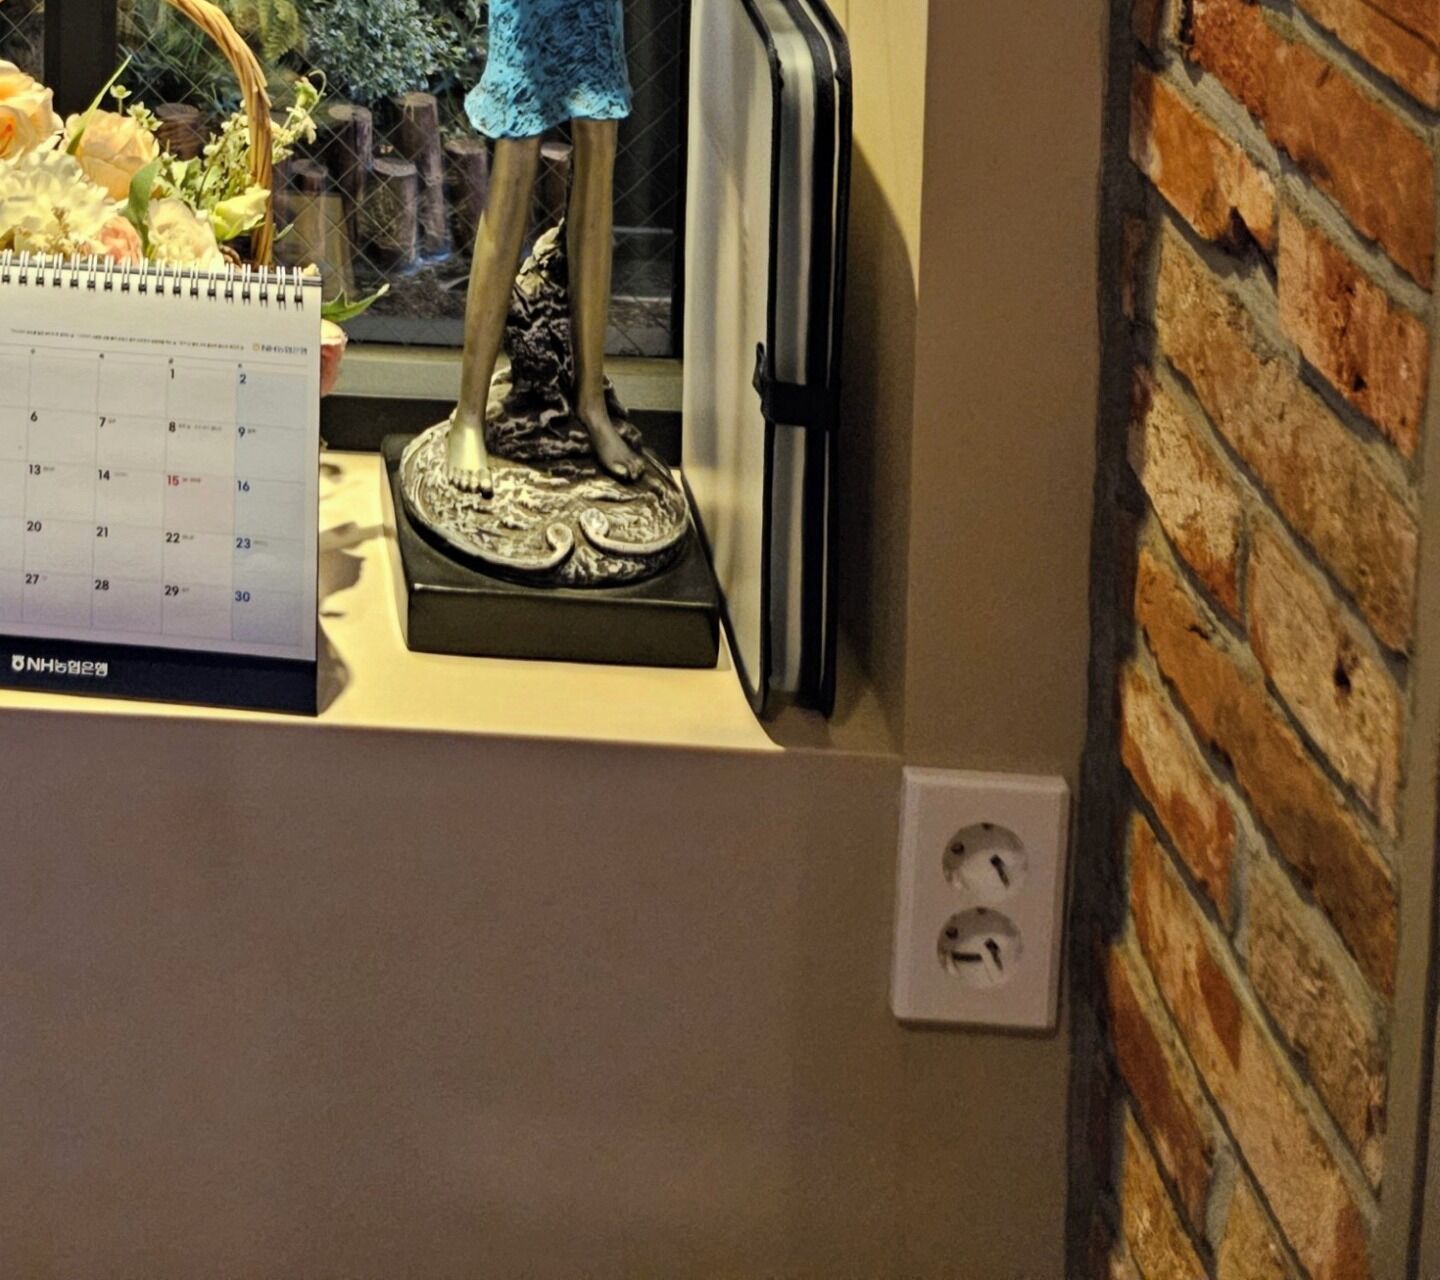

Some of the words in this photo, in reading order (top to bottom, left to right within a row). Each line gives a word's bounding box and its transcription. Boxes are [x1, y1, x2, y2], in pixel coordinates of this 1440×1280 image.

[239, 373, 247, 385] 2
[30, 411, 39, 423] 6
[99, 416, 107, 428] 7
[168, 421, 177, 433] 8
[237, 426, 246, 438] 9
[29, 463, 41, 476] 13
[98, 468, 111, 481] 14
[167, 474, 180, 487] 15
[237, 479, 250, 492] 16
[26, 520, 42, 533] 20
[96, 525, 109, 538] 21
[165, 531, 181, 544] 22
[235, 537, 251, 550] 23
[25, 573, 40, 585] 27
[94, 579, 110, 591] 28
[164, 584, 180, 597] 29
[234, 590, 251, 603] 30
